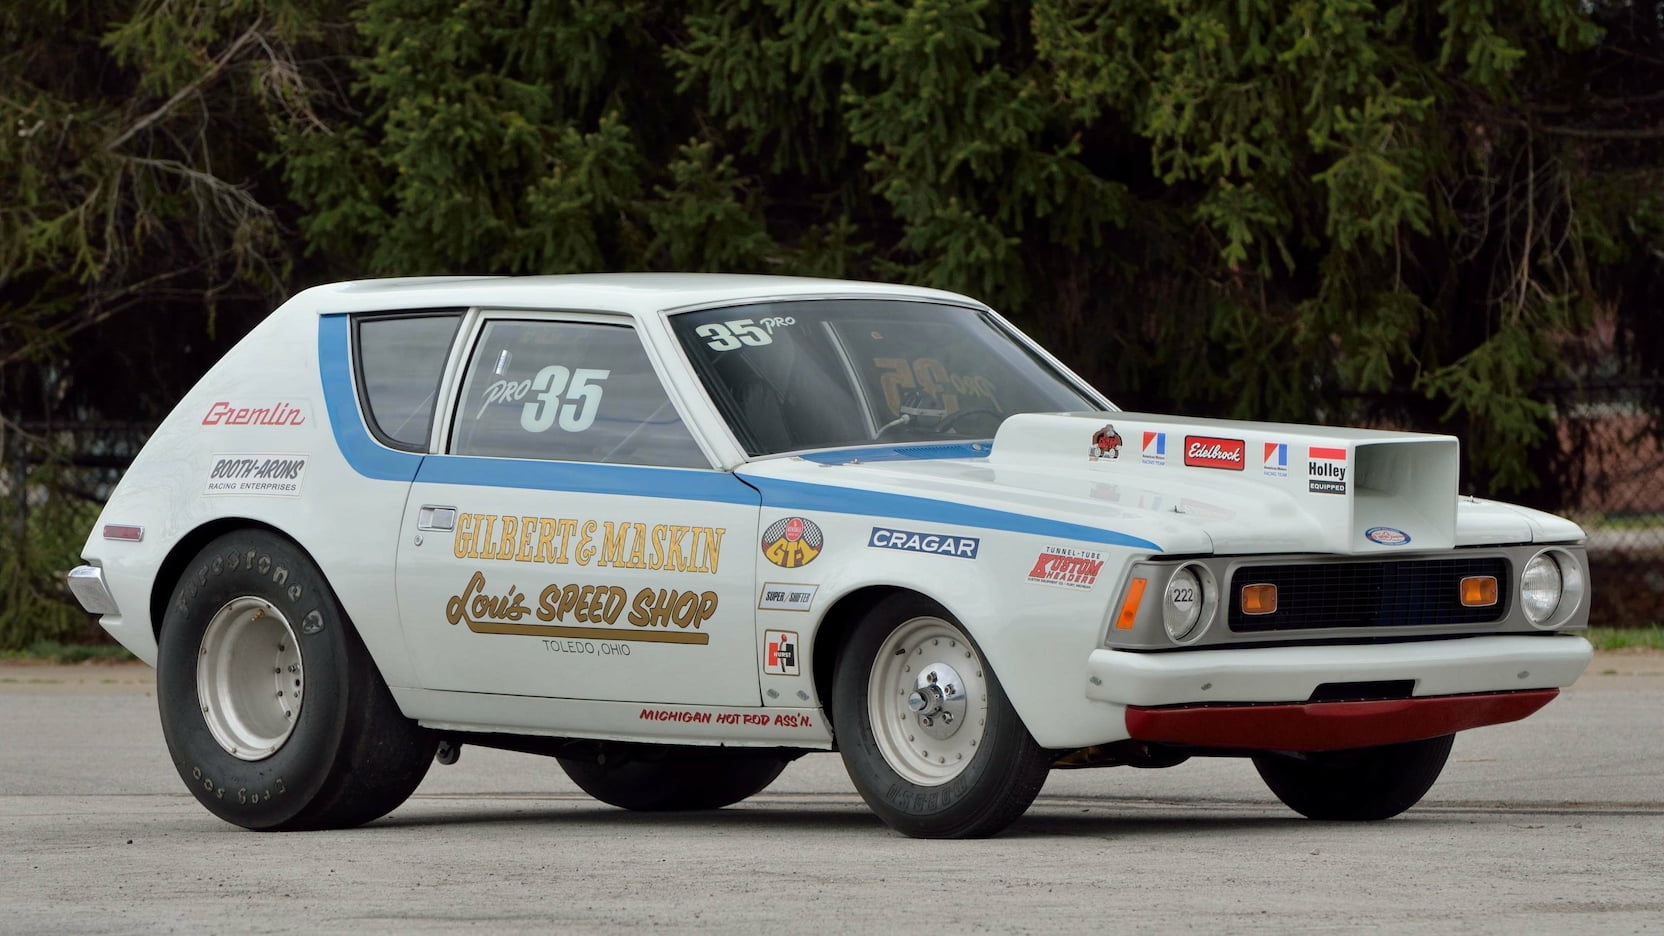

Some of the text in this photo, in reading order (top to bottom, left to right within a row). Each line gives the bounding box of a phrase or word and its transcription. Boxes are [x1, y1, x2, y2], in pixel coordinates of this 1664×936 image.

[696, 316, 796, 352] 35 PRO
[476, 365, 611, 433] PRO 35
[201, 401, 305, 427] Gremlin
[1188, 442, 1241, 463] Edelbrock
[210, 458, 304, 480] BOOTH-ARONS
[1309, 461, 1346, 481] Holley
[208, 482, 297, 491] RACING ENTERPRISES
[1310, 482, 1345, 492] EQUIPPED
[453, 512, 726, 574] GILBERT & MASKIN
[872, 530, 976, 557] CRAGAR
[1046, 546, 1101, 560] TUNNEL-TUBE
[1028, 553, 1105, 579] KUSTOM
[1045, 570, 1096, 585] HEADERS
[445, 571, 719, 629] Lou's SPEED SHOP
[1174, 588, 1193, 603] 222
[639, 708, 813, 728] MICHIGAN HOT ROD ASS'N.
